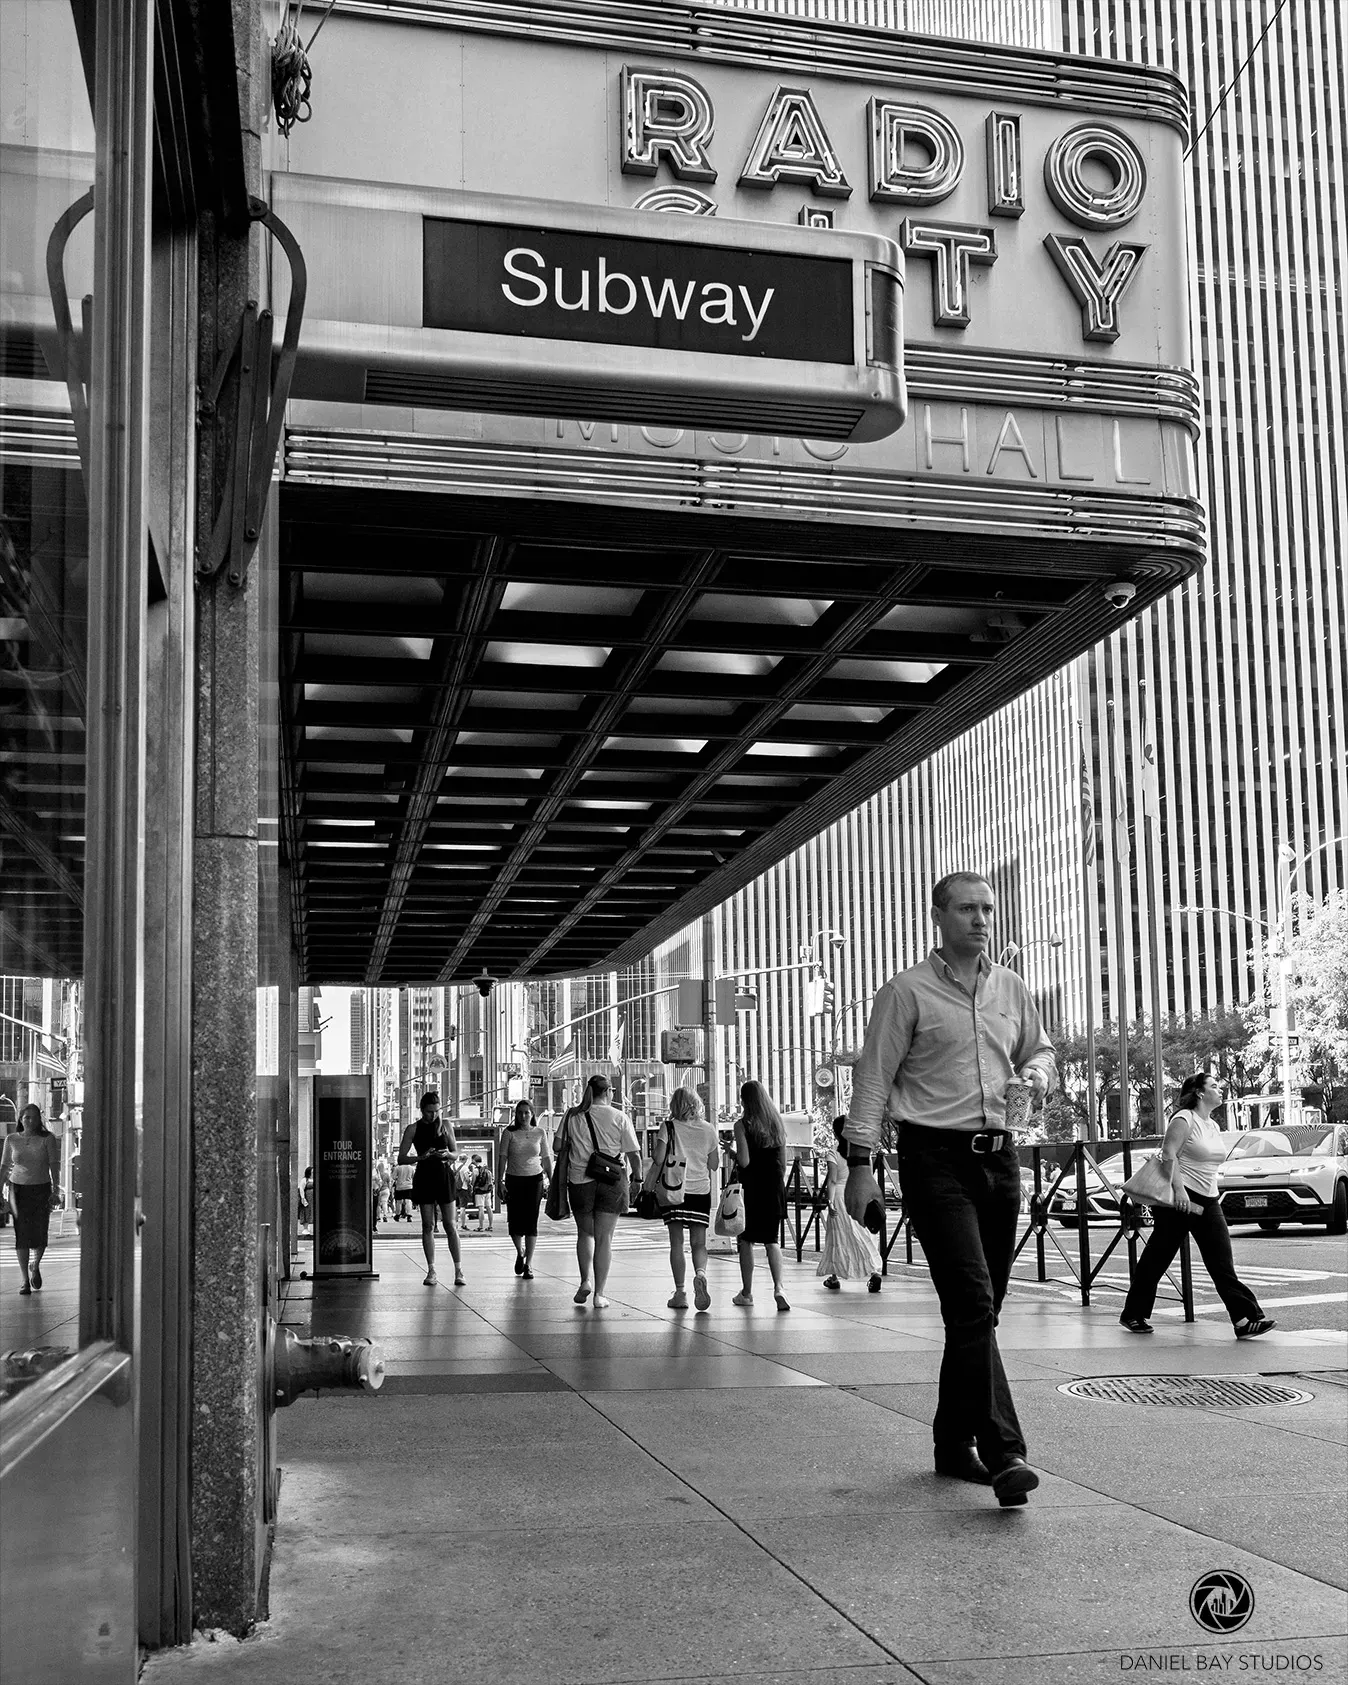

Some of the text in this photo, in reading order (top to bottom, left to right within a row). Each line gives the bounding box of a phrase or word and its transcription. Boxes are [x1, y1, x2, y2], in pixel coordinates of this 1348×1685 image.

[620, 64, 1147, 231] RADIO
[501, 248, 775, 341] Subway
[632, 185, 1151, 343] TY
[924, 404, 1151, 485] HALL
[323, 1151, 362, 1160] ENTRANCE
[333, 1141, 353, 1150] TOUR
